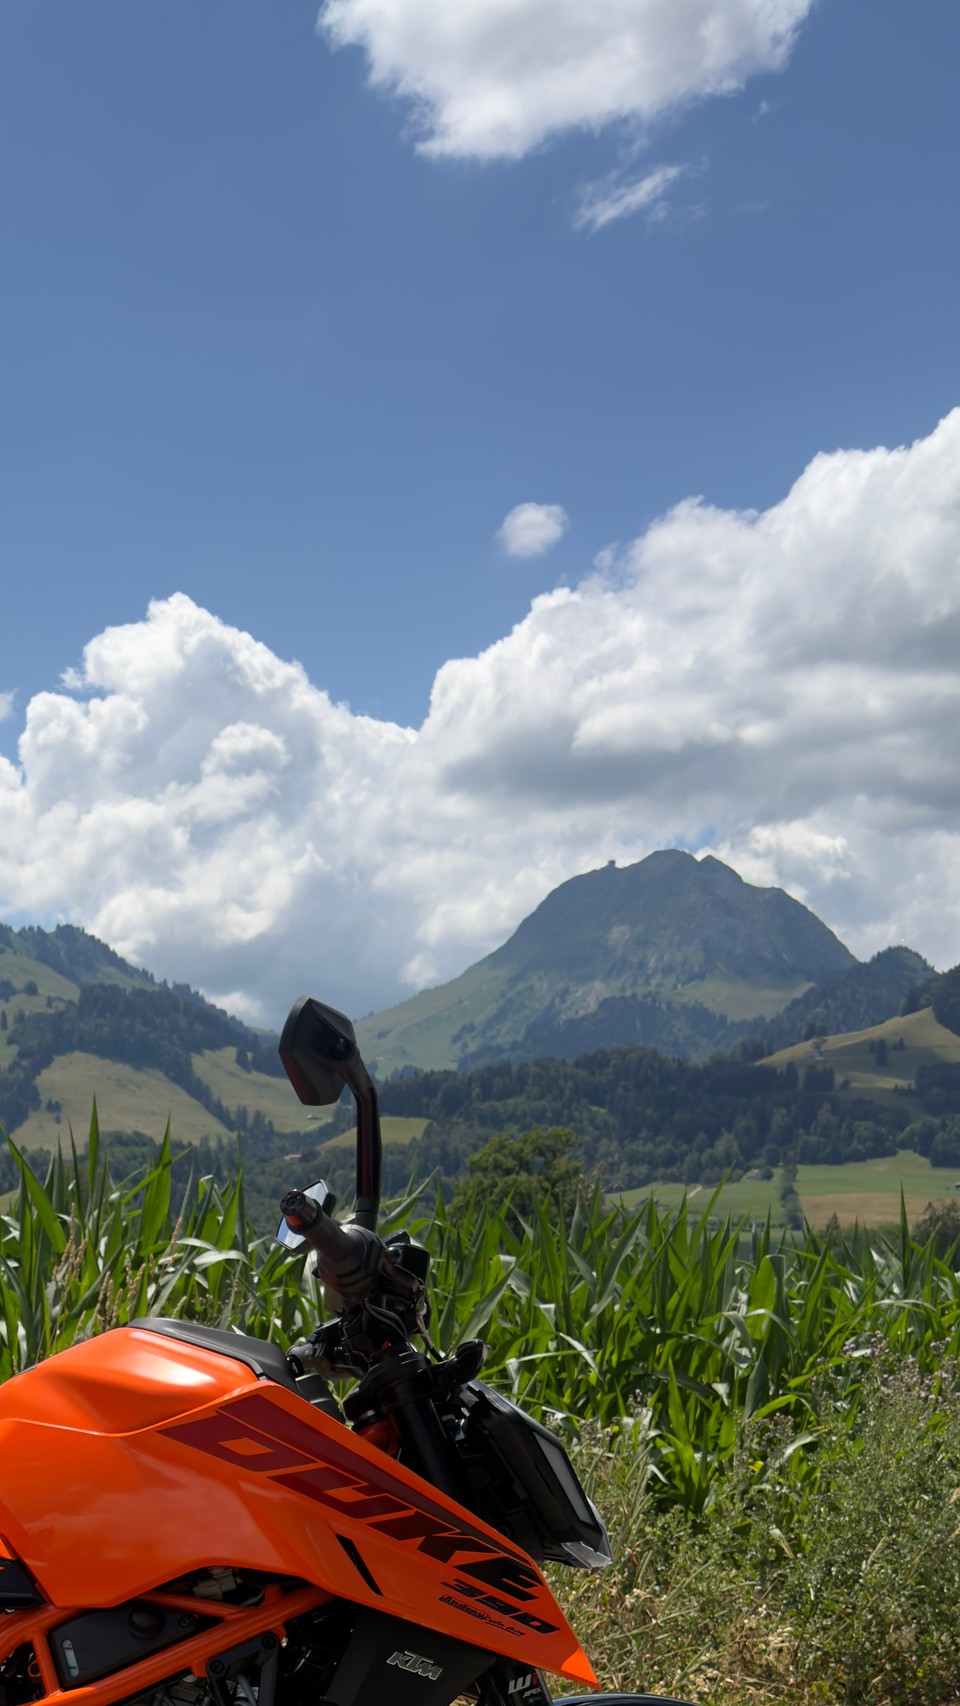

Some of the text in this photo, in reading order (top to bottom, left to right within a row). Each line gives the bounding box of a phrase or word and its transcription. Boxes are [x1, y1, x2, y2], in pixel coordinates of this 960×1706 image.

[156, 1412, 544, 1602] DUKE
[440, 1578, 560, 1634] 390
[386, 1650, 443, 1680] KTM
